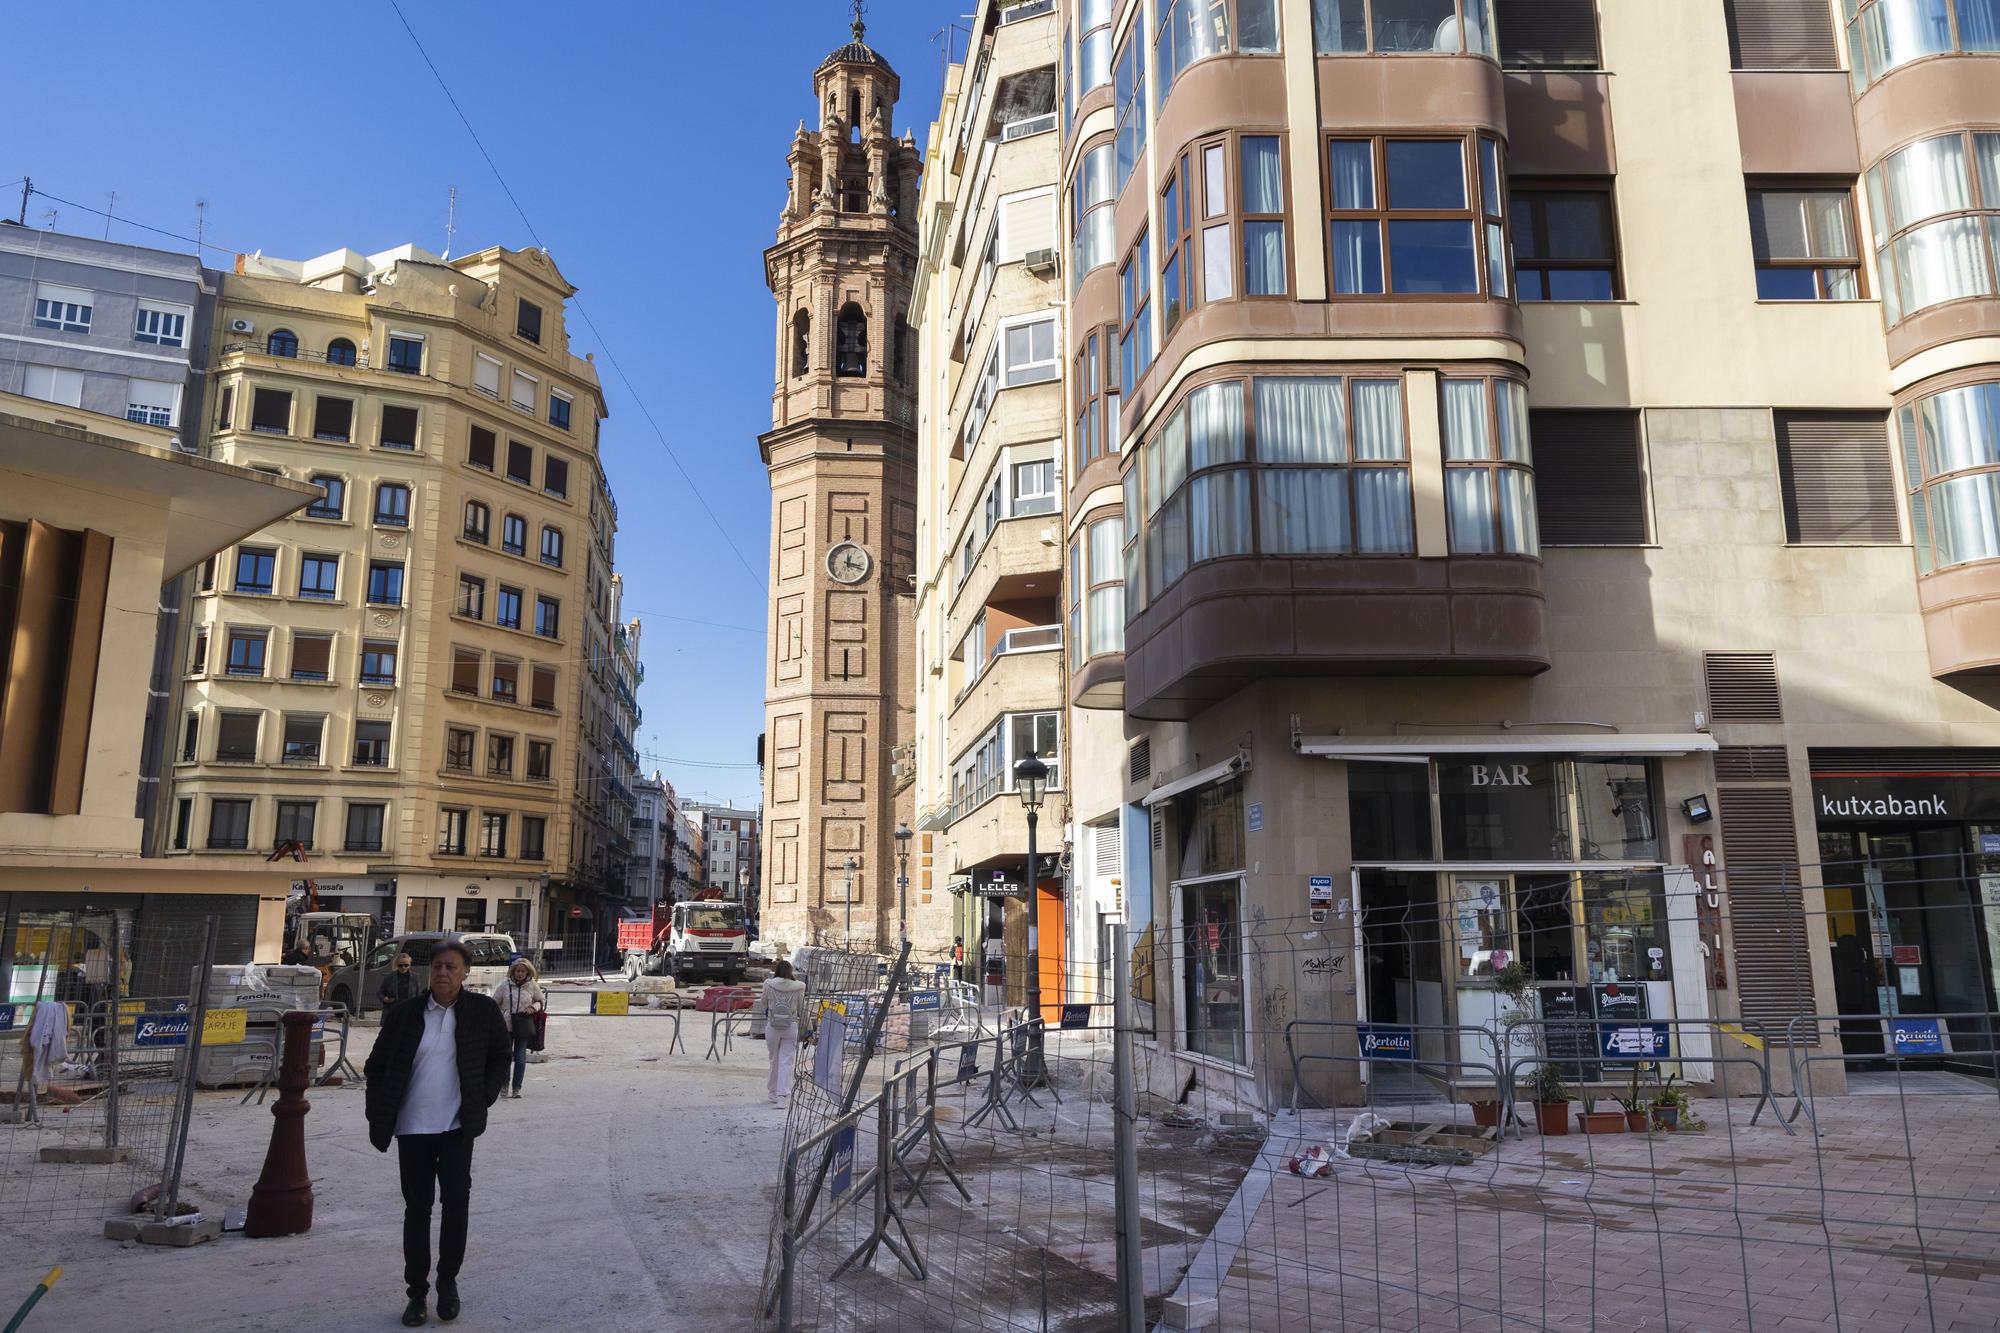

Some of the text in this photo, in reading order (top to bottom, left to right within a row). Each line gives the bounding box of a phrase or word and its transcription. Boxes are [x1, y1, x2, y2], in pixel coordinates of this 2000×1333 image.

[1470, 765, 1533, 786] BAR
[1822, 794, 1947, 816] kutxabank
[979, 883, 1018, 891] LELES
[236, 993, 281, 1002] Fenollar
[137, 1021, 188, 1039] Bertolí
[1365, 1034, 1410, 1051] Bertolín
